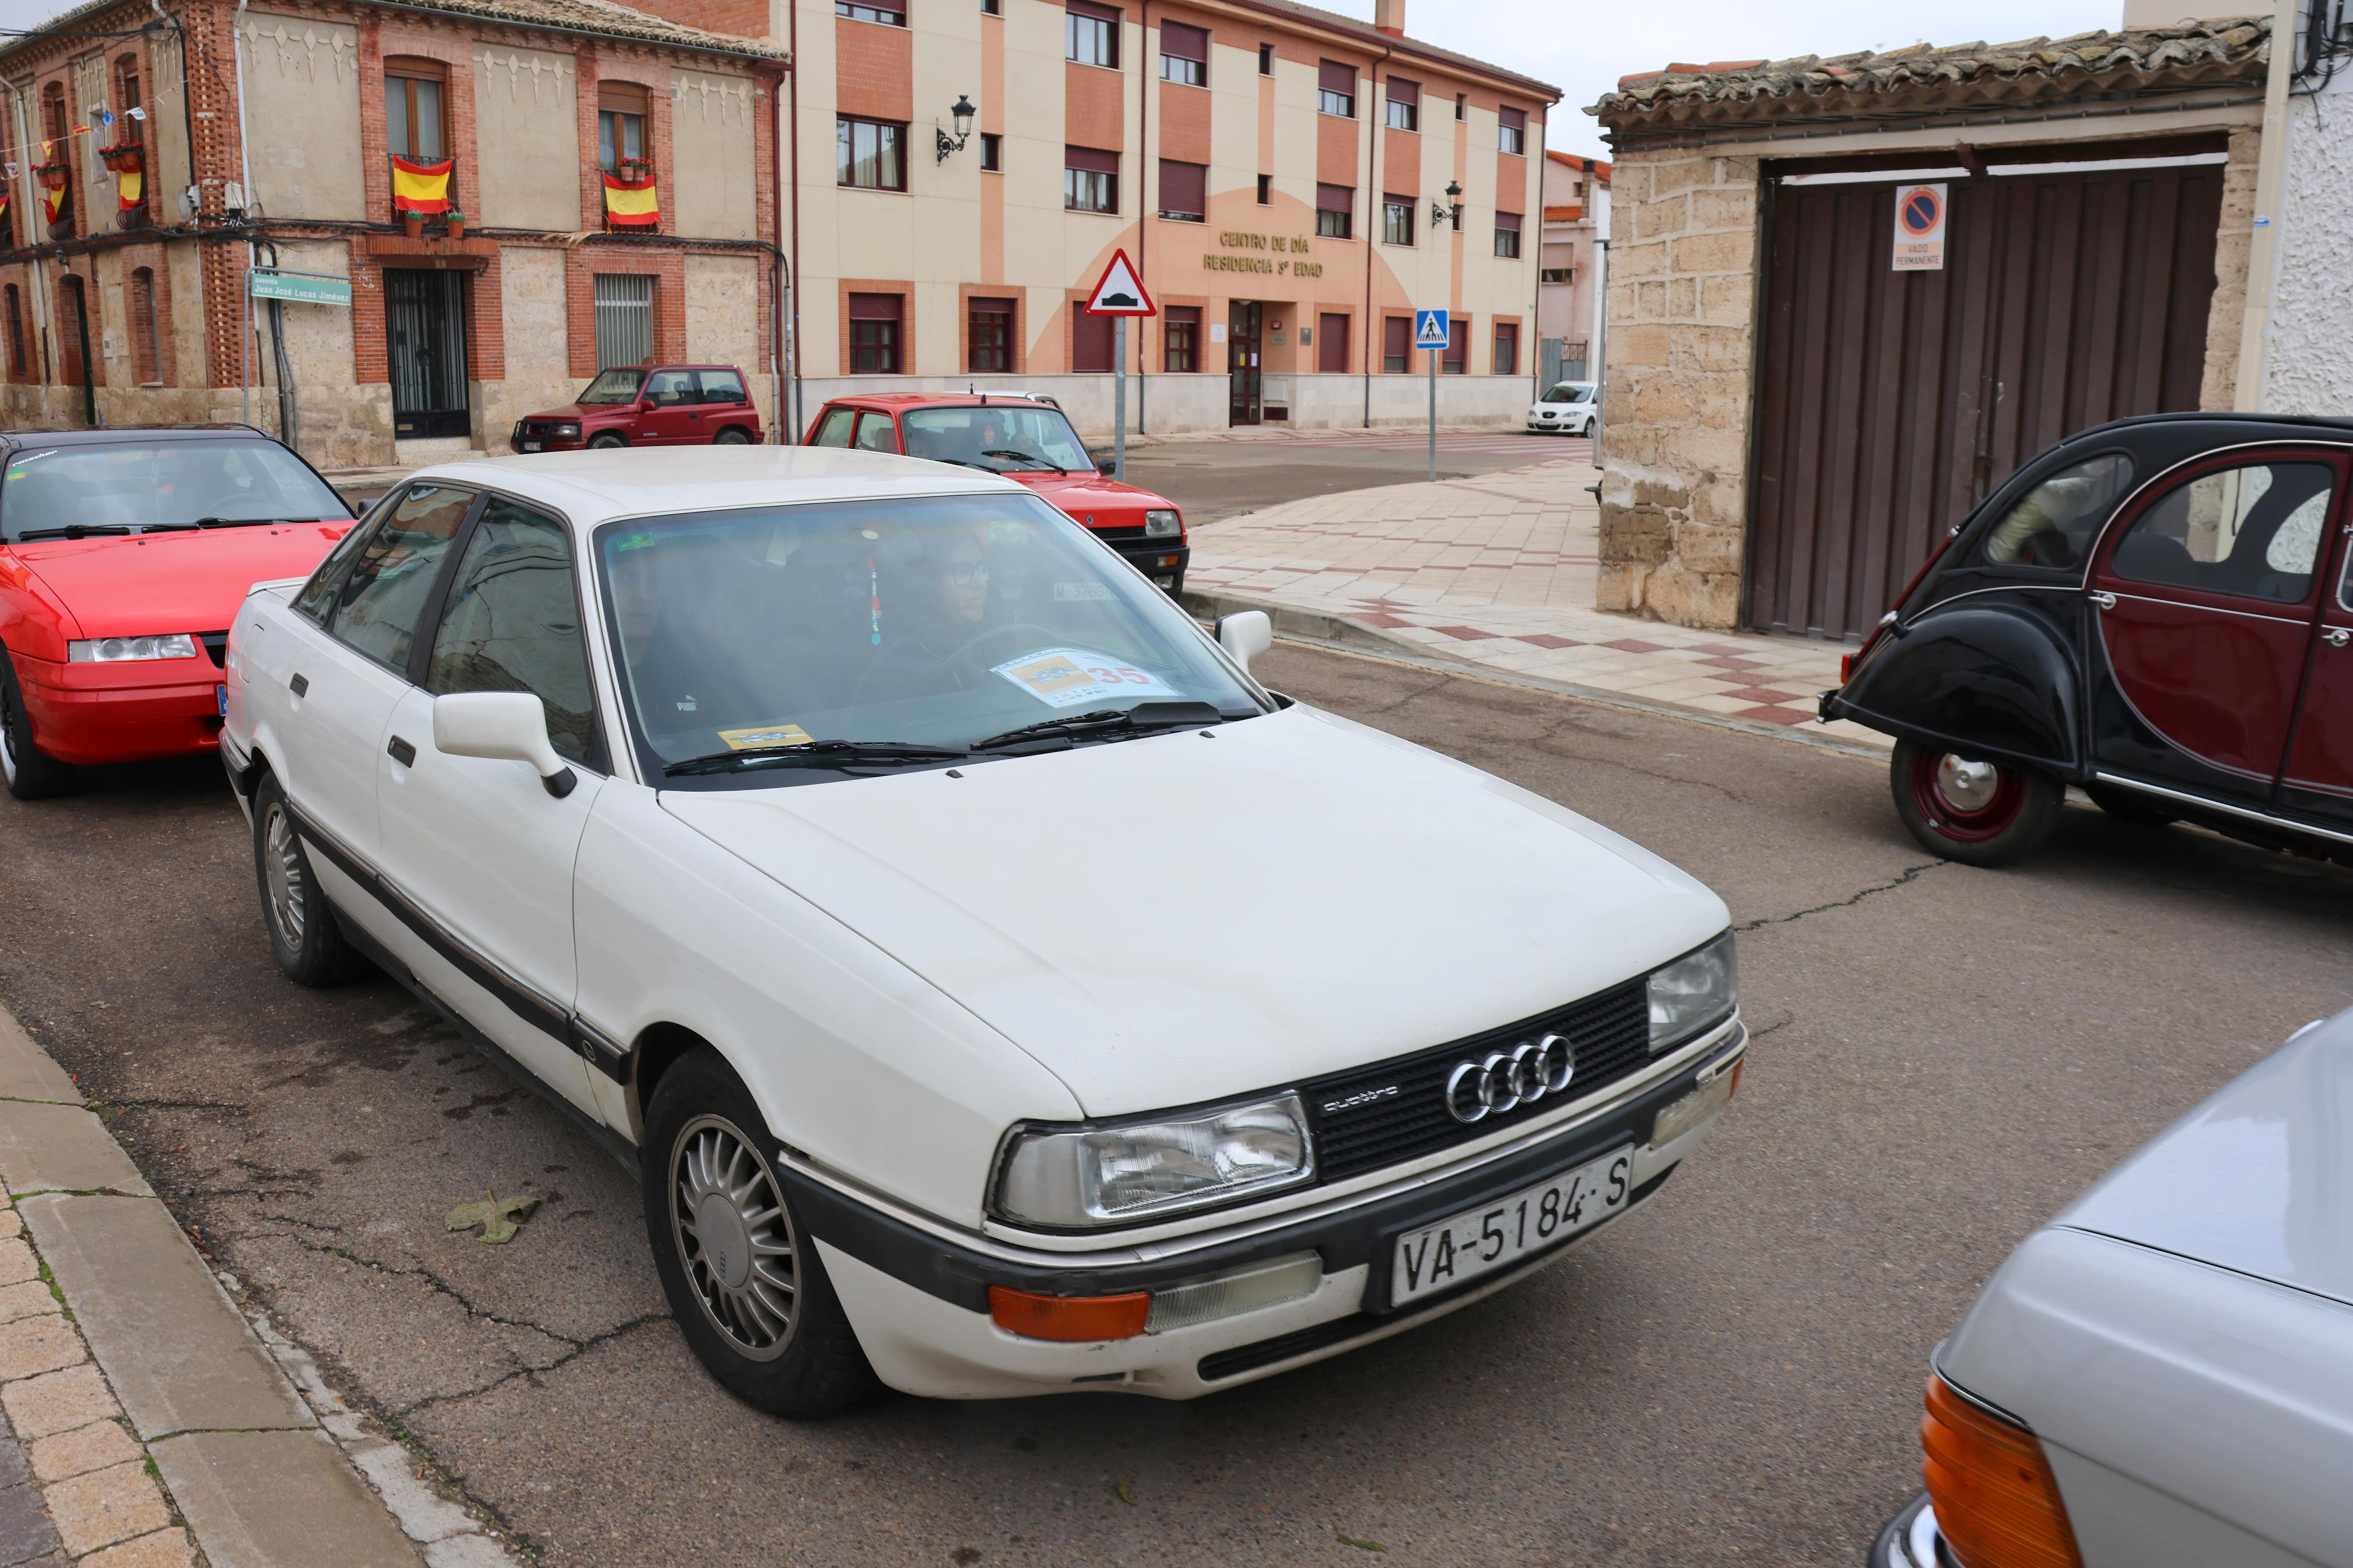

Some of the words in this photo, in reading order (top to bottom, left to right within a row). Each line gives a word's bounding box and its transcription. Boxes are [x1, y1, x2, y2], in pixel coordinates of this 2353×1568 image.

[1220, 231, 1267, 250] CENTRO
[1272, 236, 1286, 251] DE
[1290, 234, 1309, 253] DÍA
[1908, 244, 1928, 253] VADO
[1204, 254, 1273, 273] RESIDENCIA
[1294, 262, 1323, 277] EDAD
[1896, 255, 1940, 265] PERMANENTE
[255, 285, 273, 294] Juan
[275, 287, 292, 296] José
[295, 289, 316, 298] Lucas
[319, 292, 349, 301] Jiménez
[1087, 667, 1150, 684] 35
[1323, 1086, 1399, 1112] quattro
